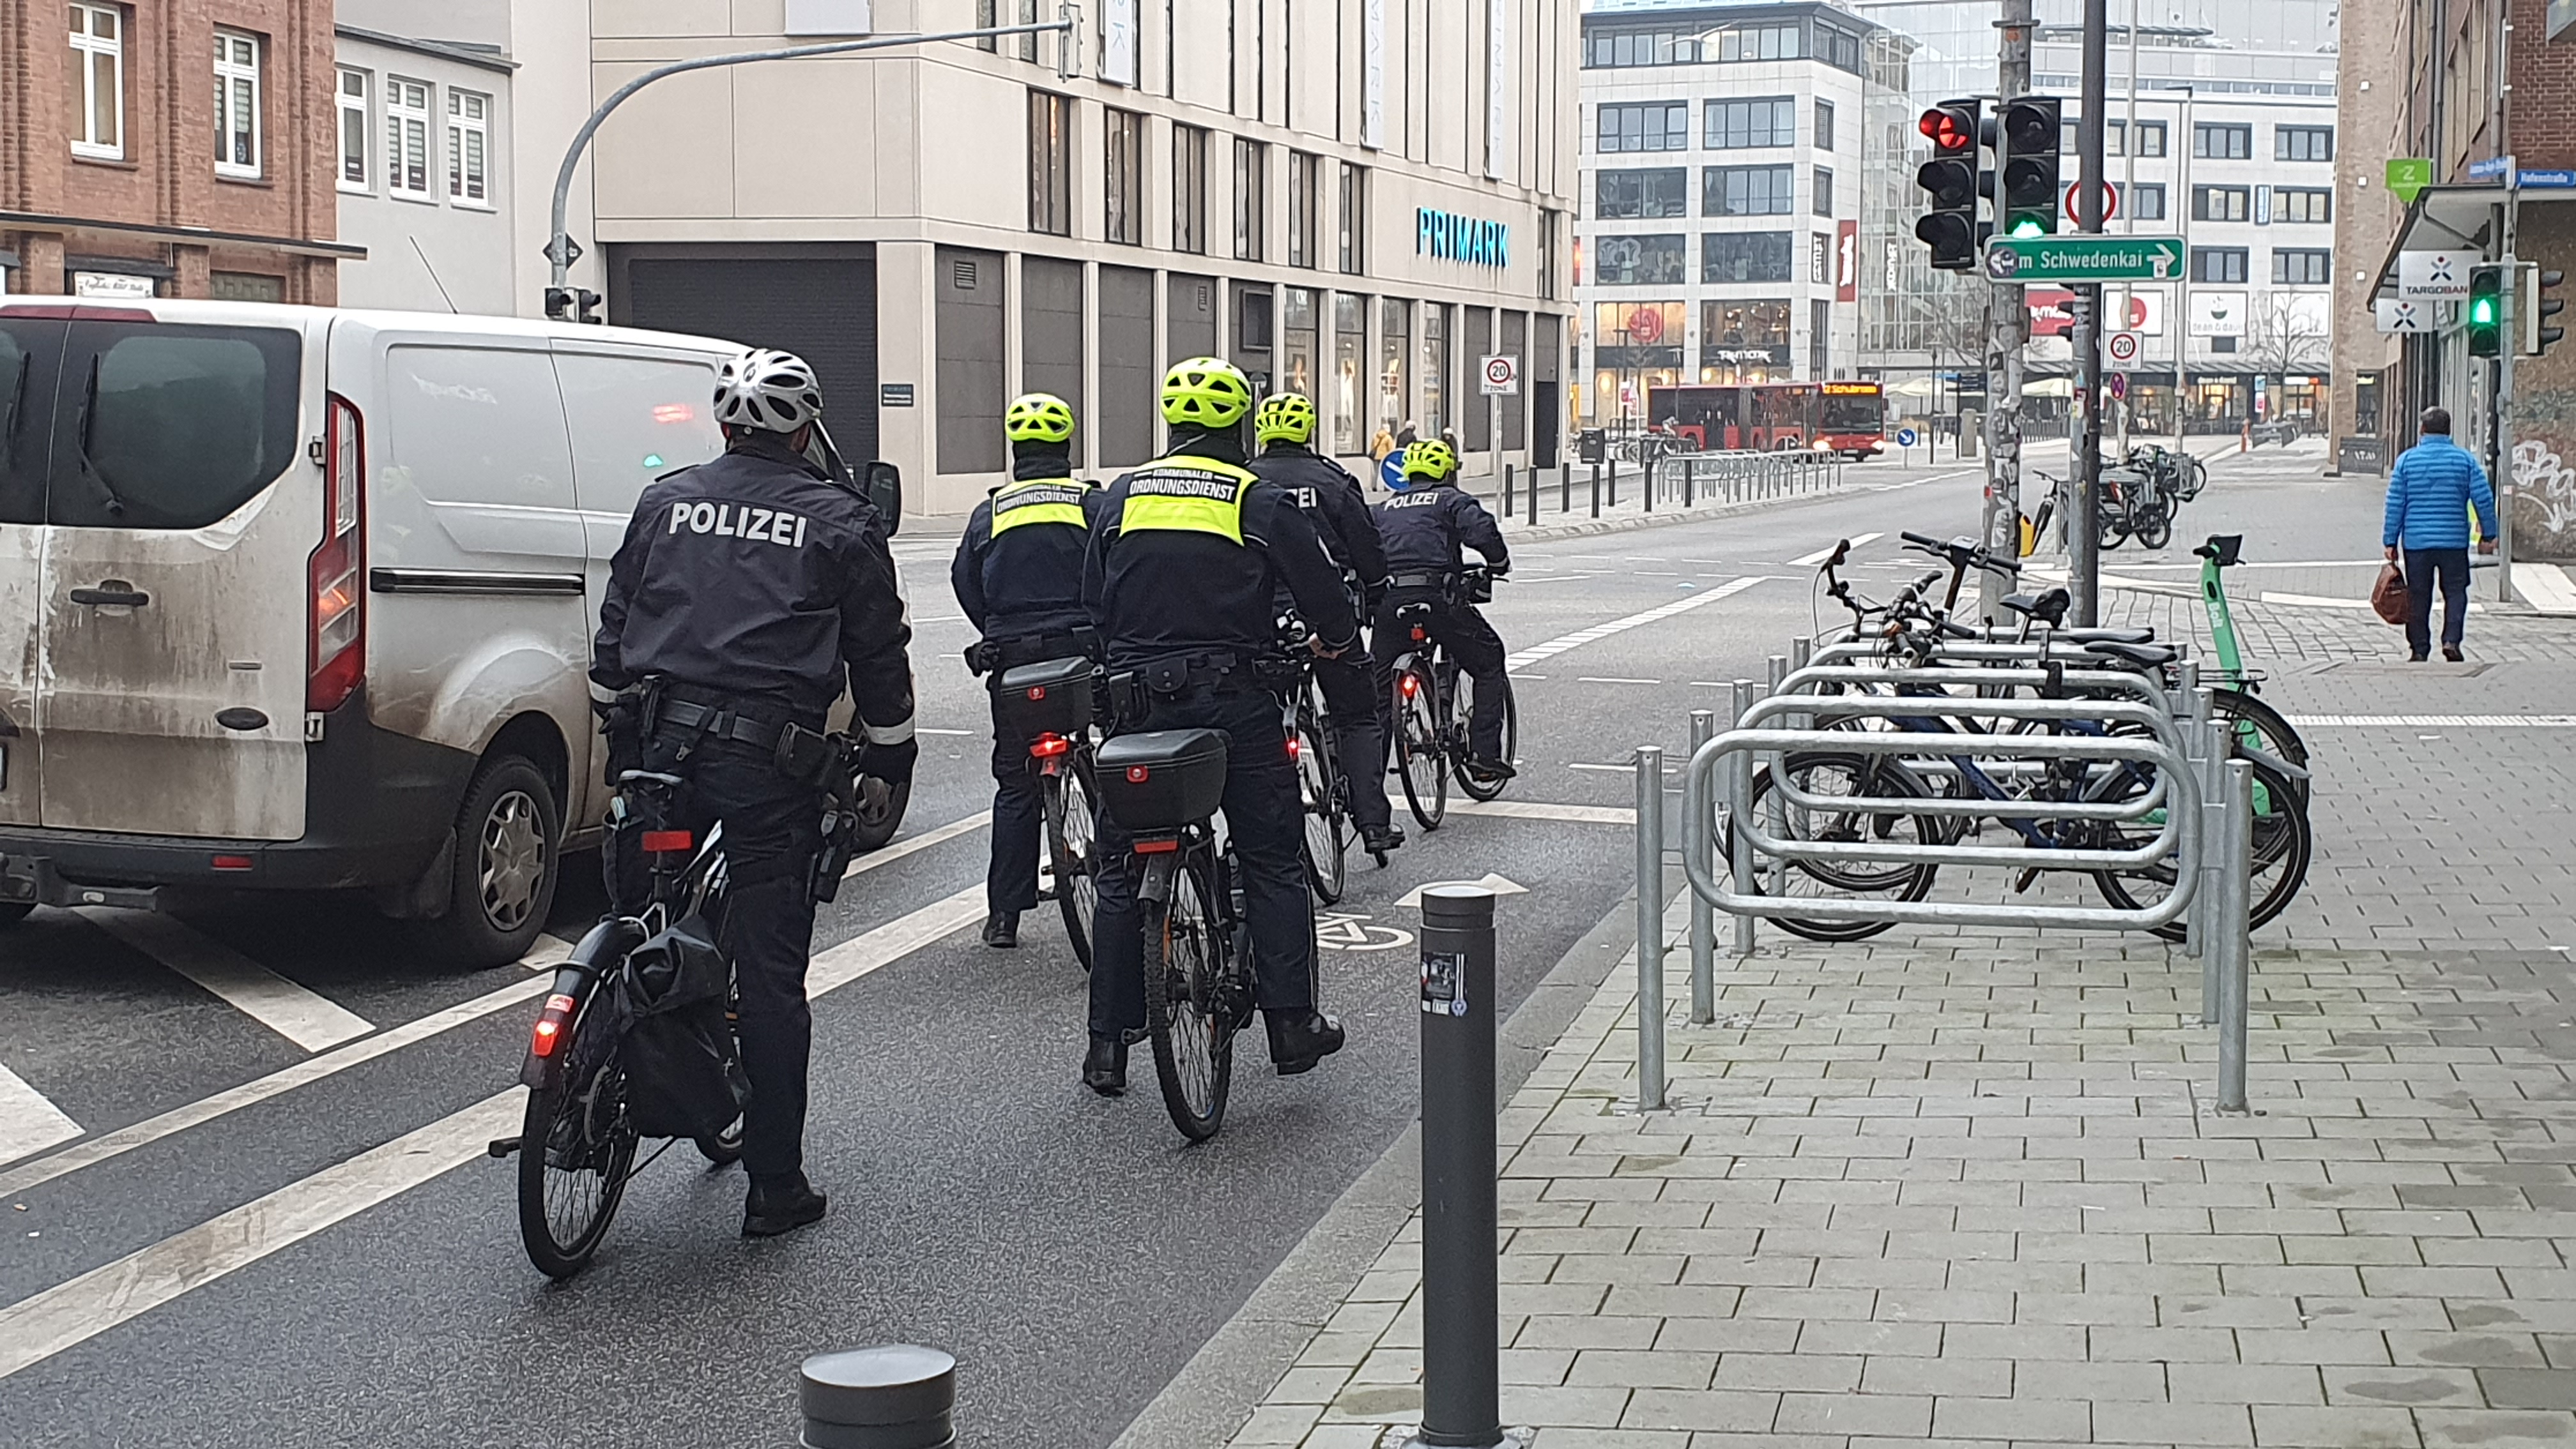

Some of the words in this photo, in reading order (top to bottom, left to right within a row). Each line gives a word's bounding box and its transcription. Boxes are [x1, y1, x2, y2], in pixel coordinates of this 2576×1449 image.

[1416, 207, 1510, 269] PRIMARK
[2040, 249, 2142, 268] Schwedenkai
[2405, 286, 2469, 294] TARGOBAN
[2116, 340, 2131, 353] 20
[1492, 365, 1506, 377] 20
[1129, 478, 1236, 501] ORDNUNGSDIENST
[1384, 492, 1439, 512] POLIZEI
[669, 503, 806, 548] POLIZEI
